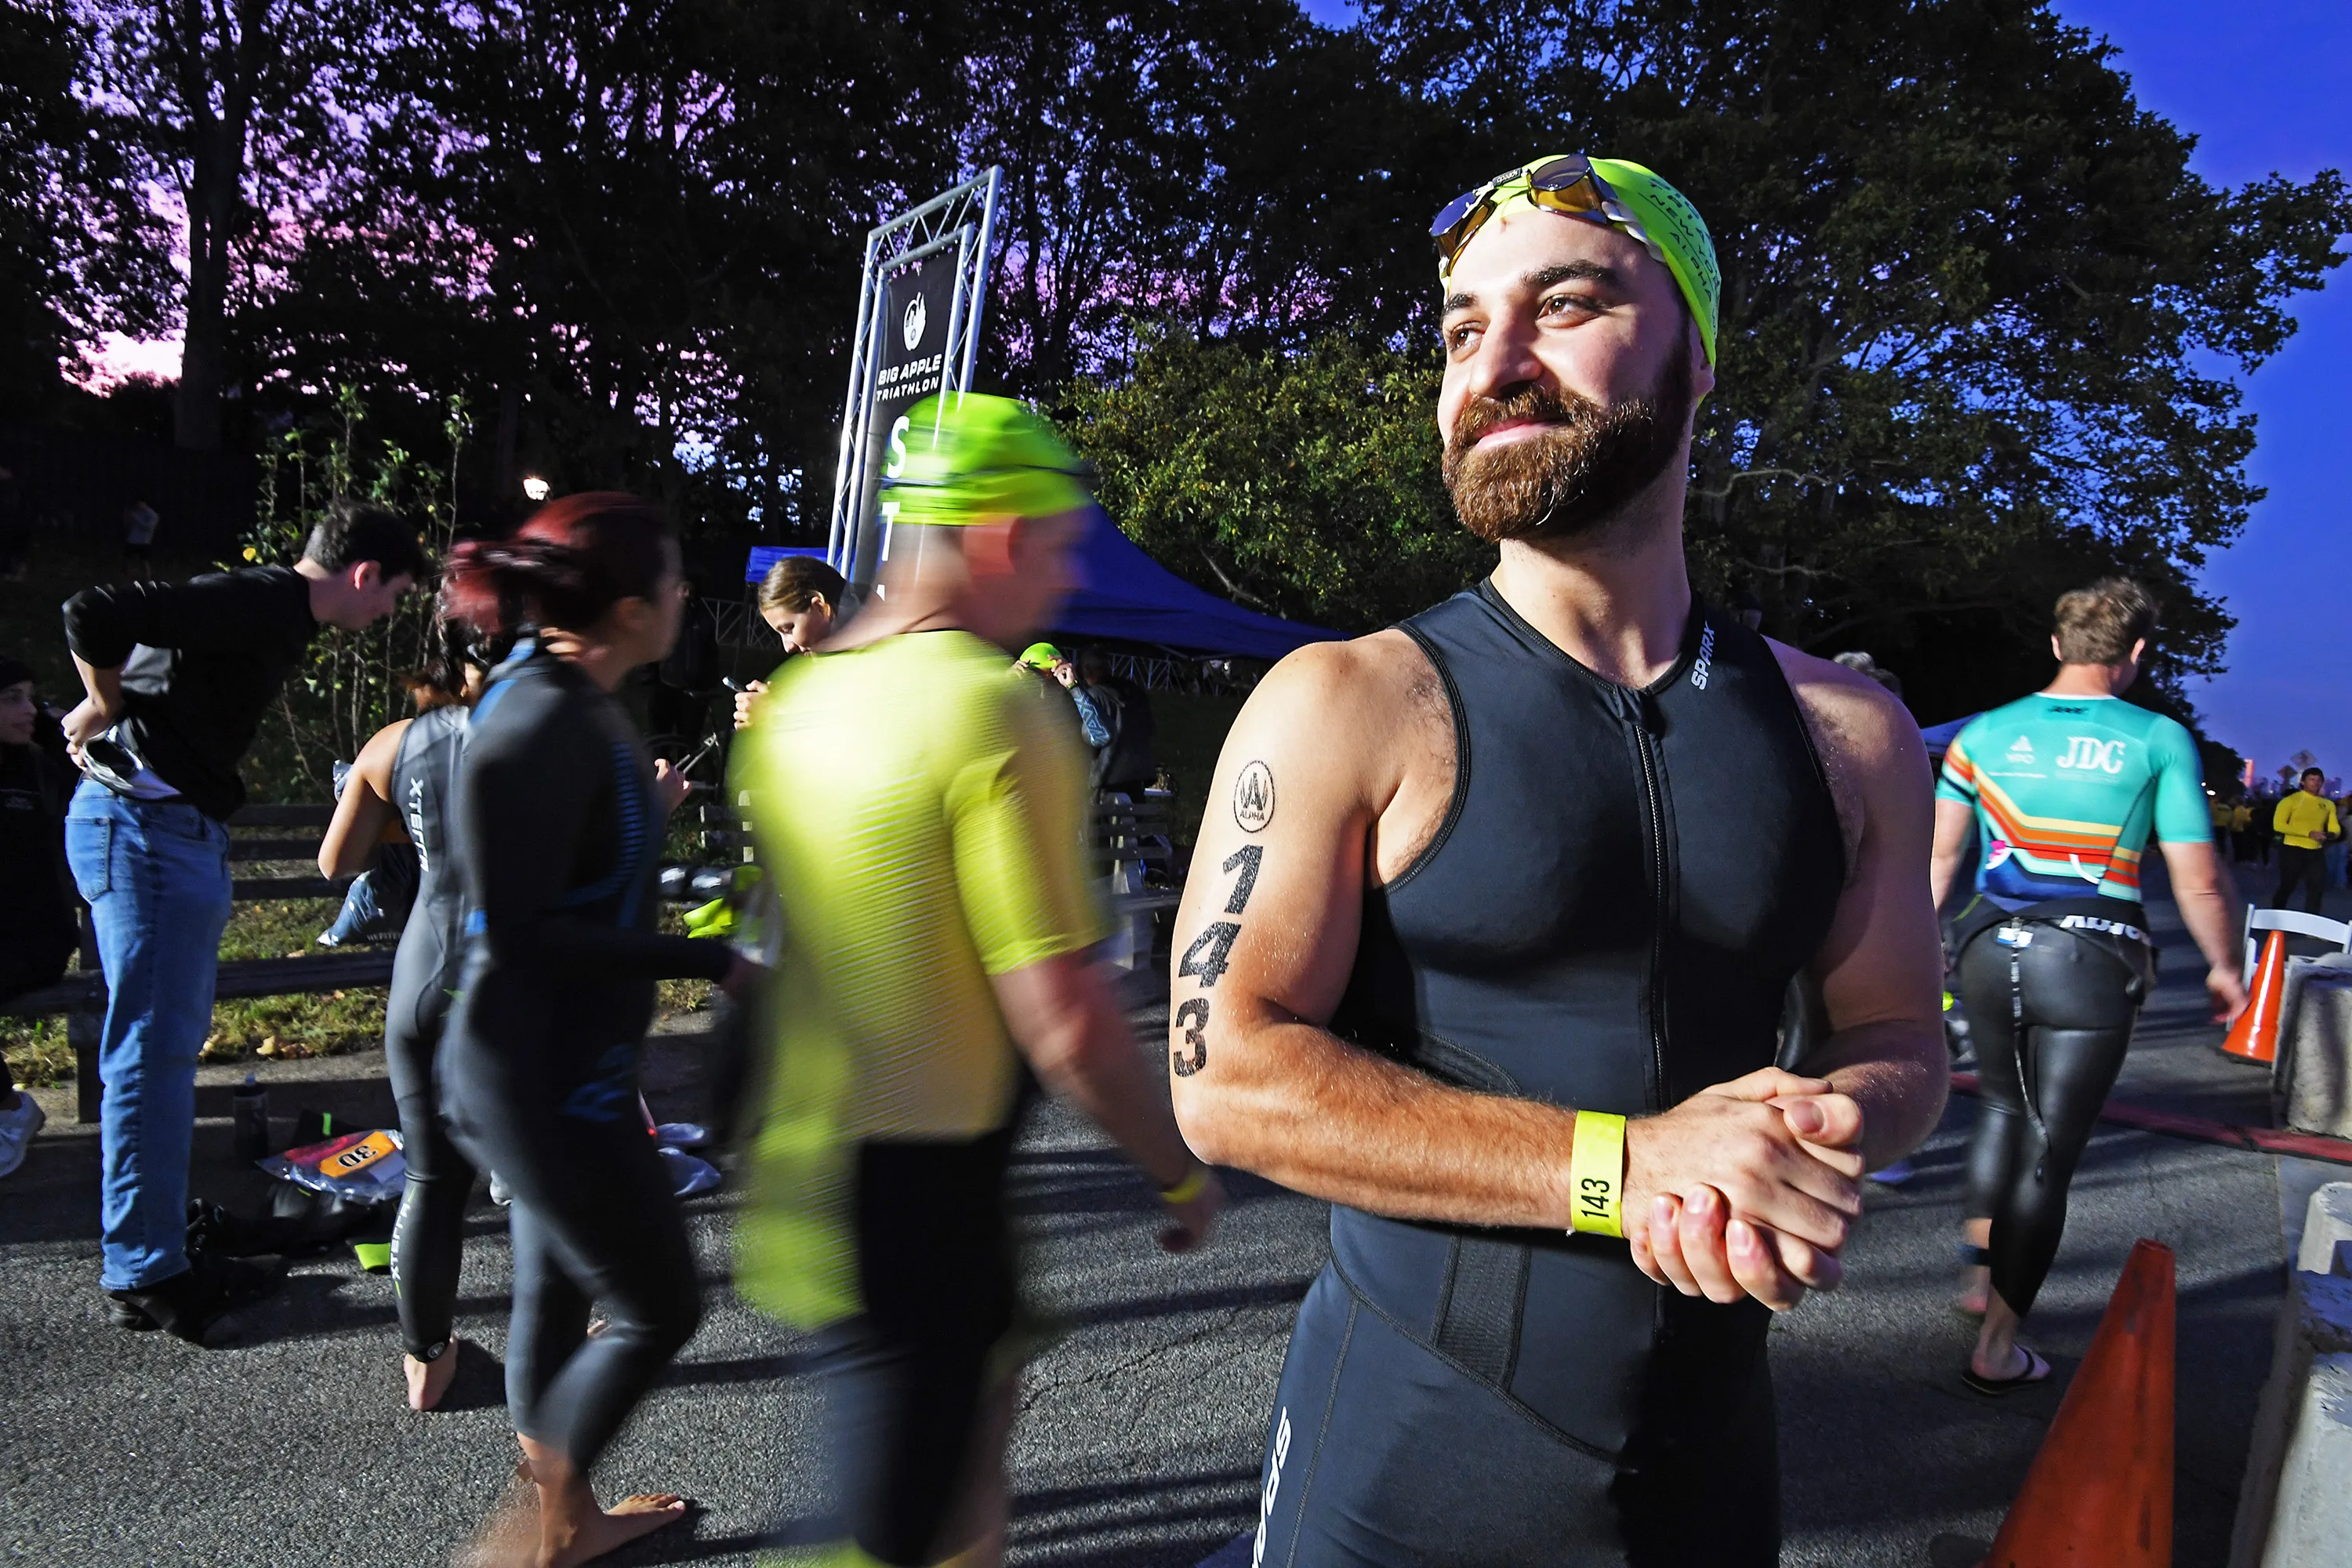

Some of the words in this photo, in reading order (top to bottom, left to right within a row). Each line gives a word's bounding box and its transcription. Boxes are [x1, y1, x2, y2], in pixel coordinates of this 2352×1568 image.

[1650, 194, 1693, 237] NEW
[1669, 231, 1712, 303] ALPHA
[876, 376, 939, 402] TRIATHLON
[877, 365, 900, 386] BIG
[899, 353, 942, 381] APPLE
[1690, 620, 1715, 691] SPARX
[2055, 735, 2127, 775] JDC
[408, 777, 430, 873] XTERRA
[1240, 809, 1265, 822] ALPHA
[1173, 844, 1264, 1078] 143
[337, 1145, 378, 1168] 30
[1581, 1178, 1610, 1218] 143
[390, 1203, 411, 1281] XTERRA
